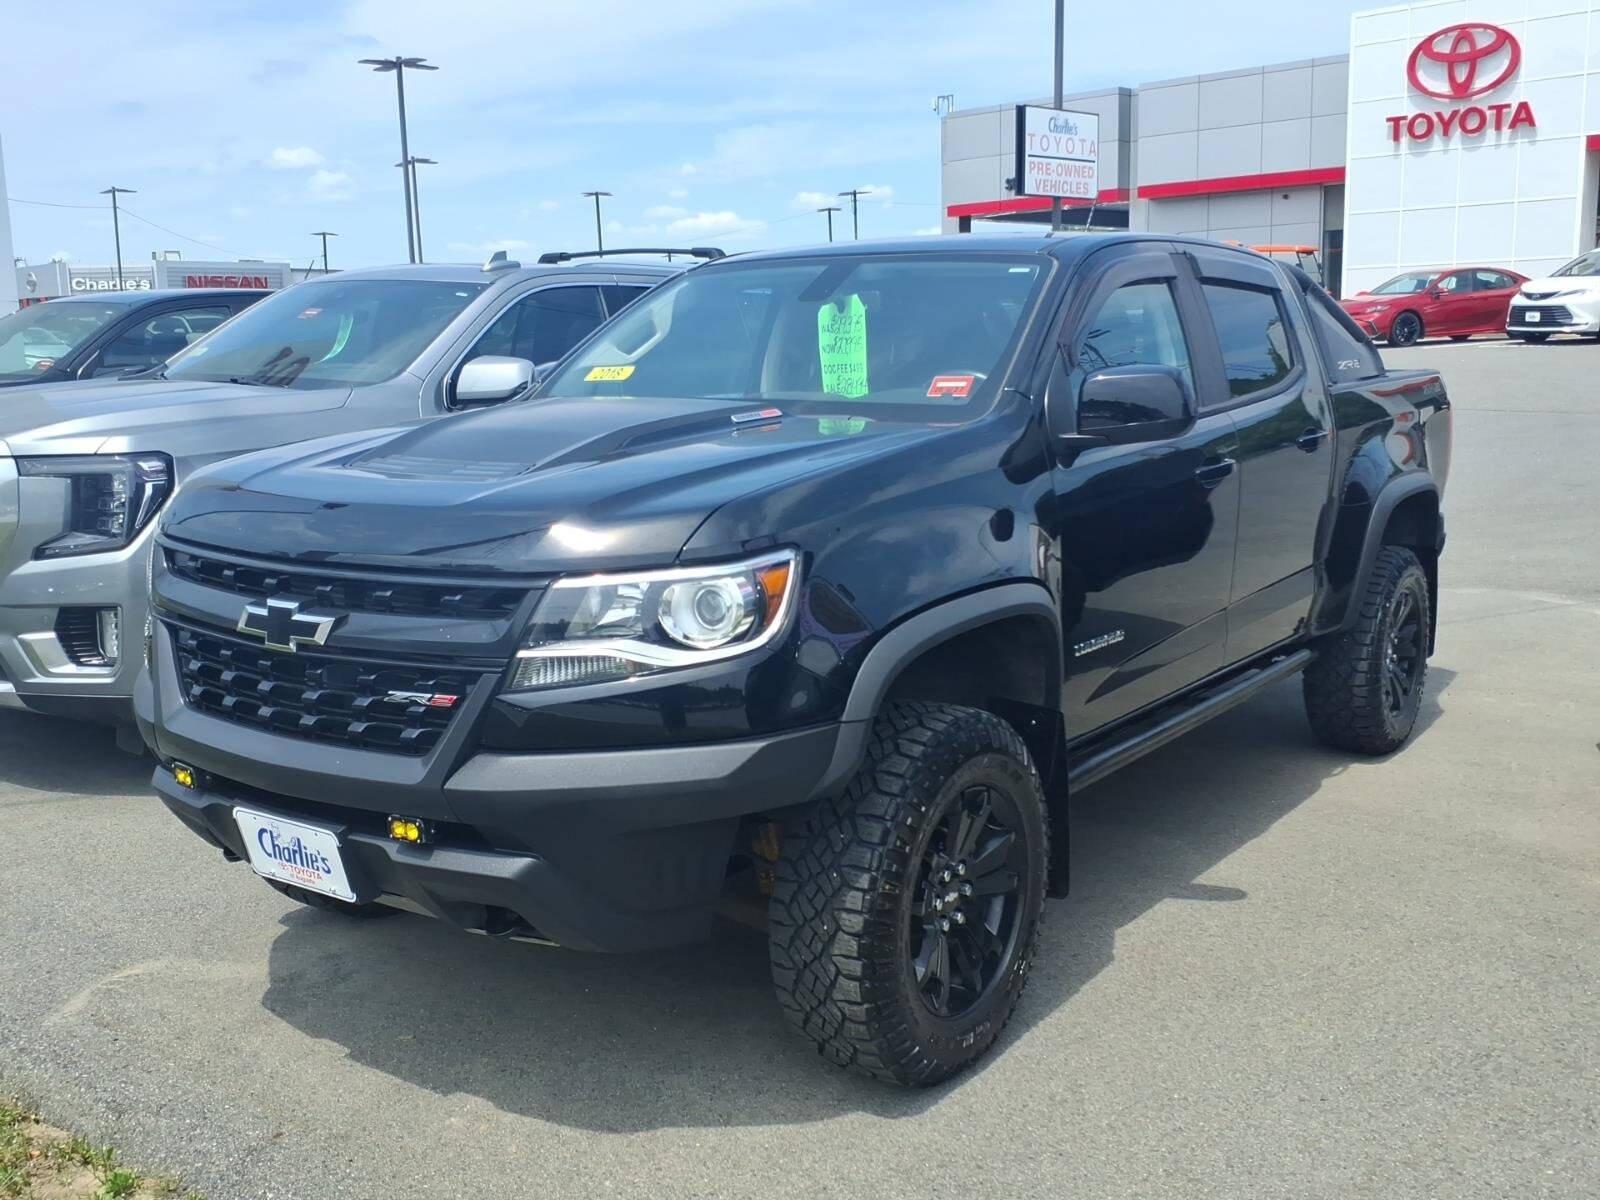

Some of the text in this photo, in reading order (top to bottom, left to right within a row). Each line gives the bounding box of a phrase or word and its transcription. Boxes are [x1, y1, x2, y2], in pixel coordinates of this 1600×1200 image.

[1048, 116, 1079, 136] Charlie's
[1385, 101, 1536, 142] TOYOTA
[1027, 133, 1097, 157] TOYOTA
[1028, 161, 1095, 179] PRE-OWNED
[1035, 178, 1089, 195] VEHICLES
[72, 276, 151, 291] Charlie's
[185, 275, 269, 289] NISSAN
[822, 343, 835, 354] NOW
[383, 690, 458, 707] ZR2
[258, 828, 332, 875] Charlie's
[289, 864, 323, 881] TOYOTA
